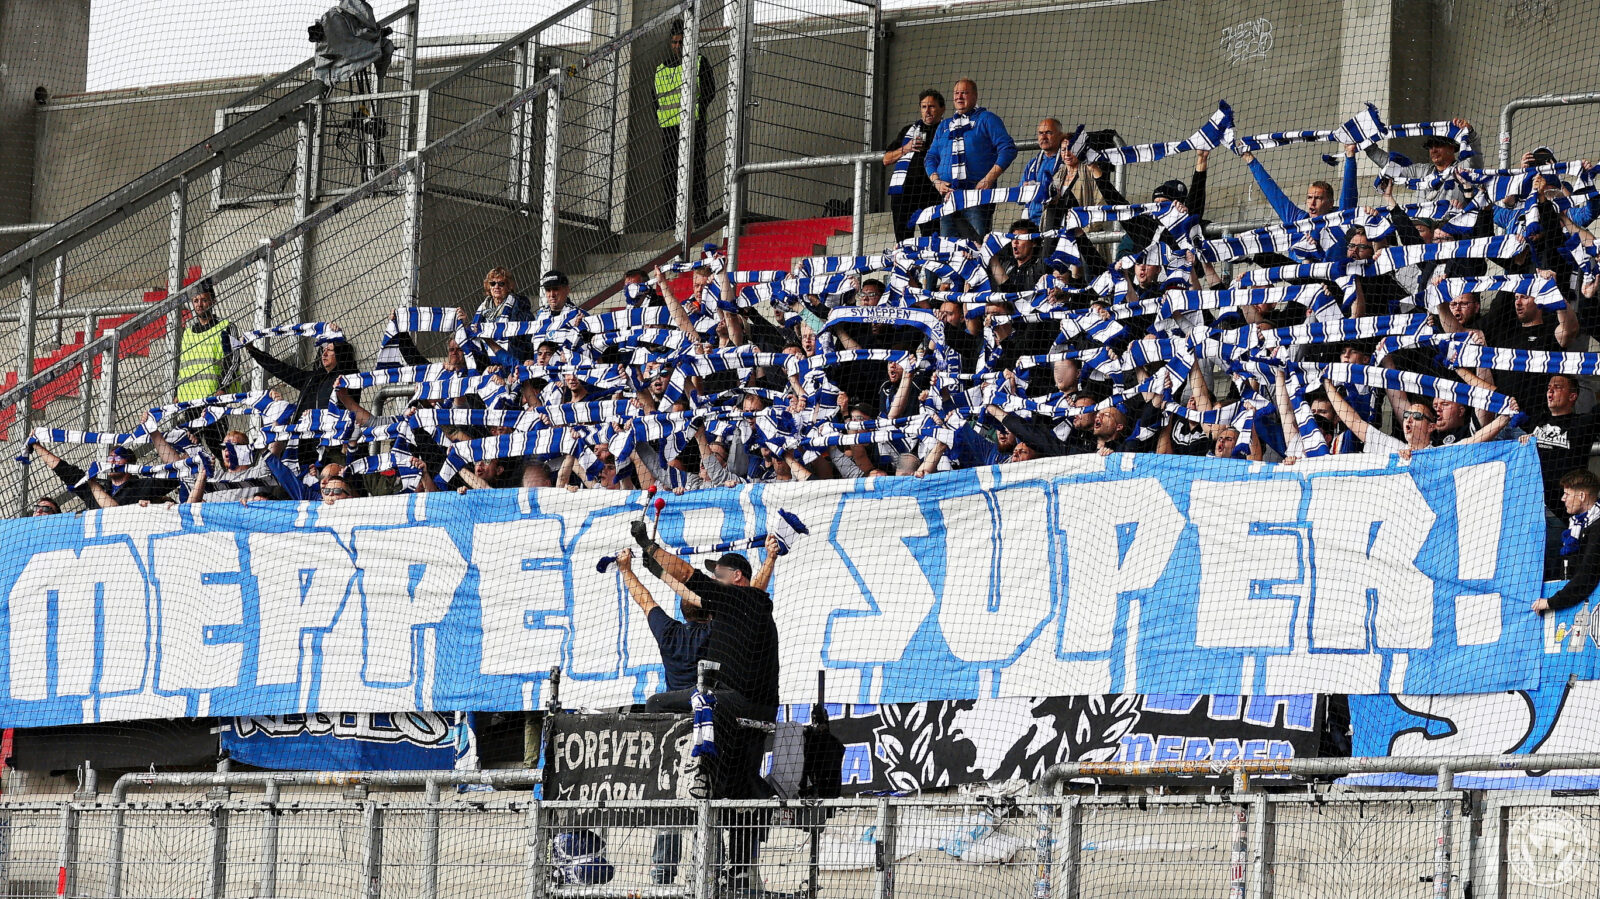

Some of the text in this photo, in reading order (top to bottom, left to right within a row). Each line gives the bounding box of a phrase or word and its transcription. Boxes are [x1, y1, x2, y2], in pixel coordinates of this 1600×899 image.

[850, 308, 911, 319] SV MEPPEN
[820, 459, 1508, 666] SUPER!
[553, 729, 655, 773] FOREVER
